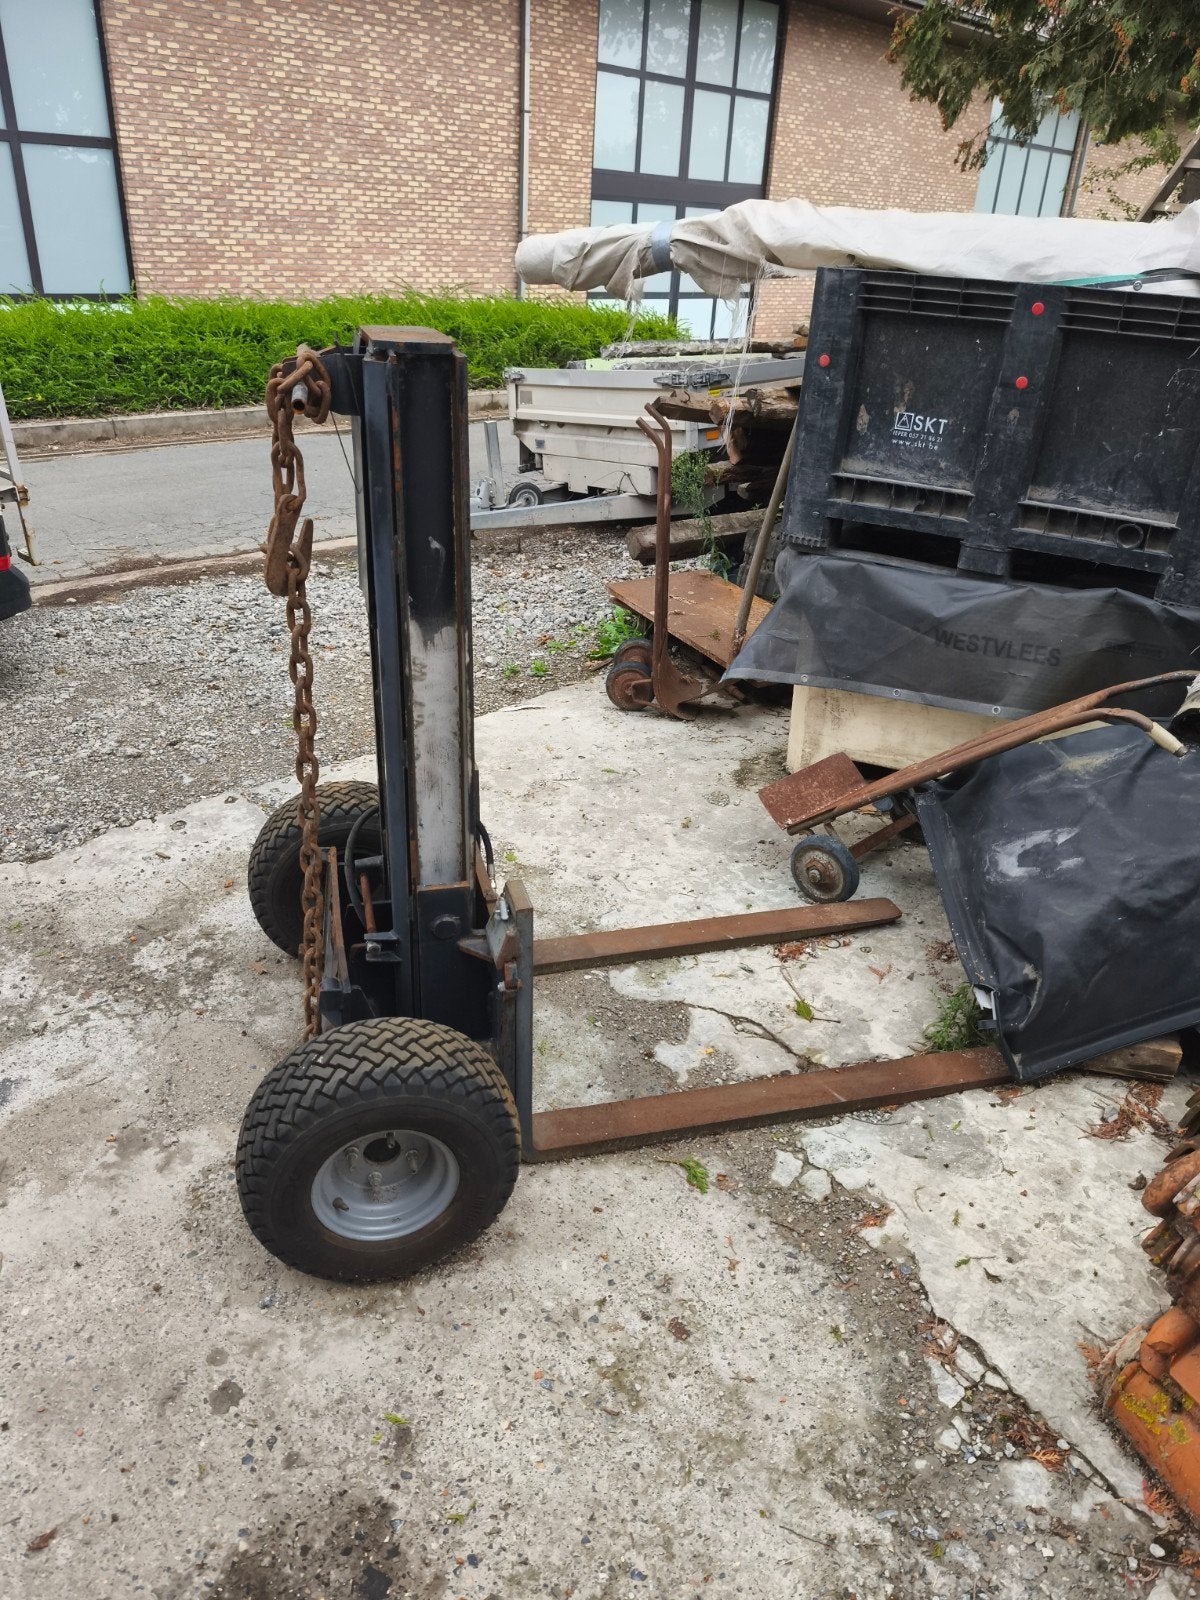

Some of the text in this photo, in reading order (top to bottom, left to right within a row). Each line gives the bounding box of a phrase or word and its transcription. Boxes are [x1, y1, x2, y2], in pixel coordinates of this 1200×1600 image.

[913, 415, 948, 434] SKT
[892, 439, 939, 450] www.sktbe
[933, 627, 1061, 667] WESTVLEES
